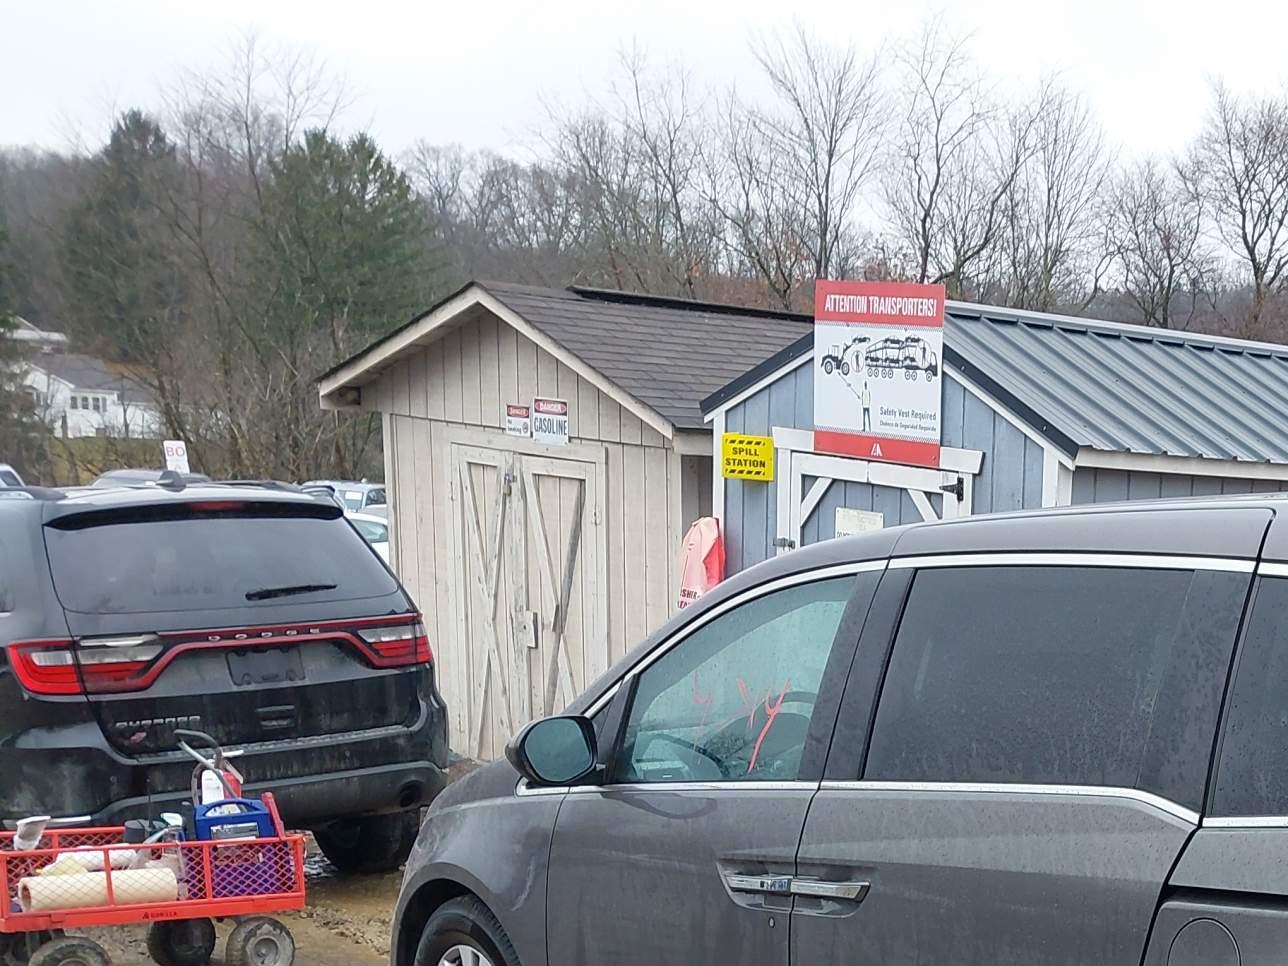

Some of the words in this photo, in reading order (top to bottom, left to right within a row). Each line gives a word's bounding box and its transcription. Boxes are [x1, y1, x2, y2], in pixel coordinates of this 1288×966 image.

[825, 294, 867, 314] ATTENTION
[869, 297, 937, 317] TRANSPORTERS!
[880, 406, 897, 418] Safety
[898, 408, 910, 418] Vest
[911, 409, 937, 421] Required
[534, 416, 568, 436] GASOLINE
[732, 447, 760, 457] SPILL
[725, 457, 766, 469] STATION
[208, 628, 320, 642] DODGE
